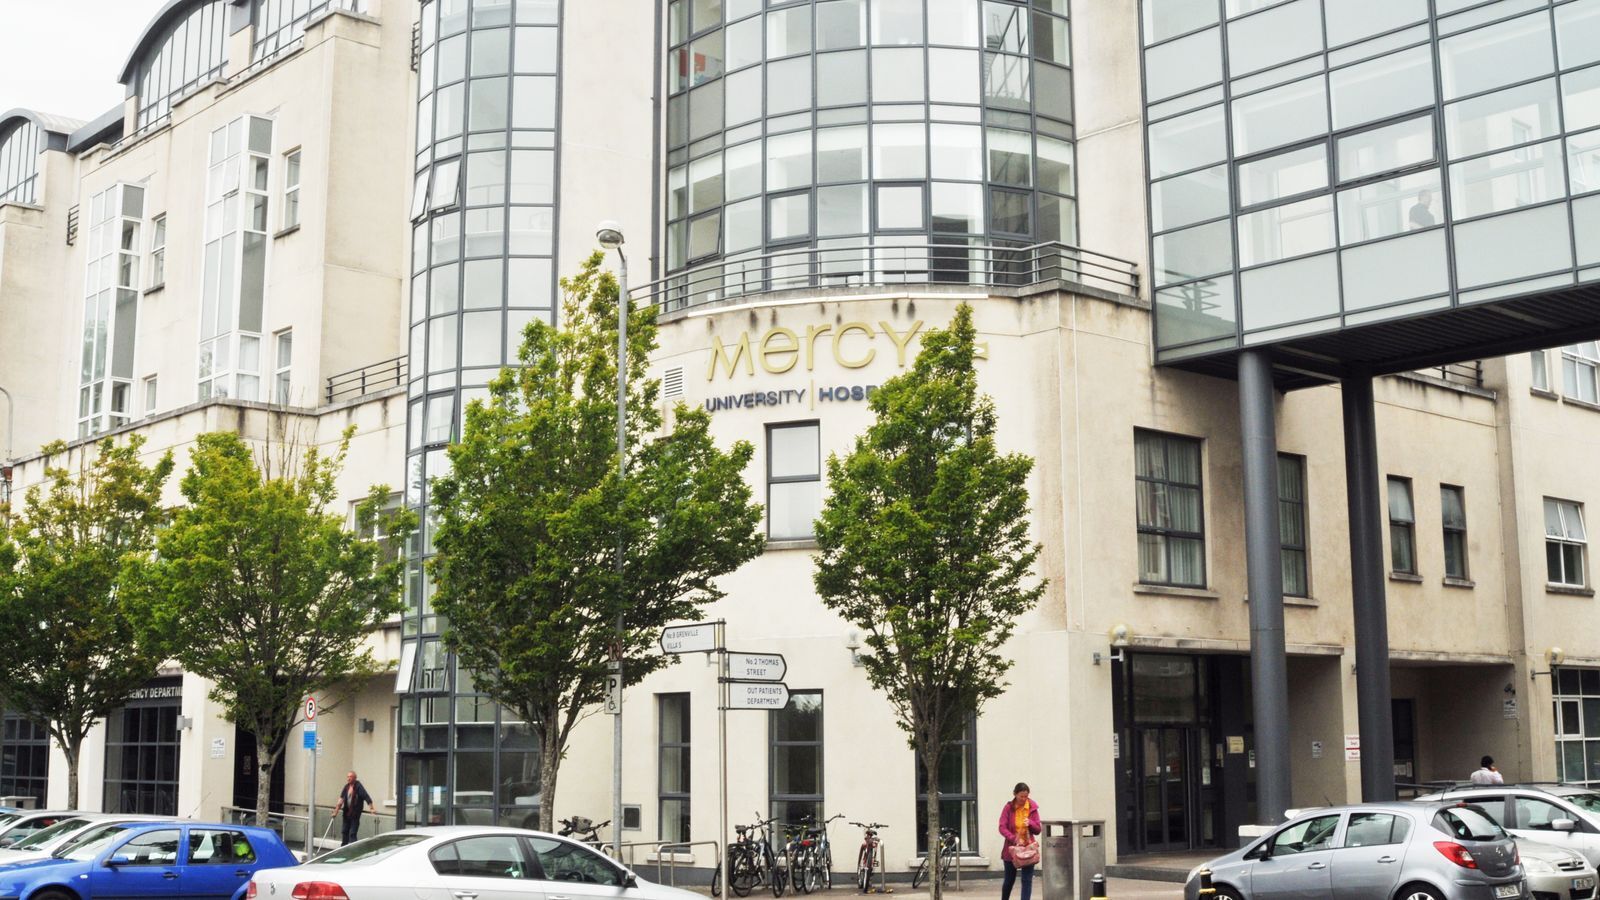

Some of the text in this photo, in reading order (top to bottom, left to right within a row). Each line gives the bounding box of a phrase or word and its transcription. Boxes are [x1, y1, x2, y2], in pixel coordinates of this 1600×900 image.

[705, 388, 806, 413] UNIVERSITY
[758, 658, 779, 666] THOMAS
[746, 668, 767, 676] STREET
[758, 687, 782, 695] PATIENTS
[747, 697, 780, 705] DEPARTMENT
